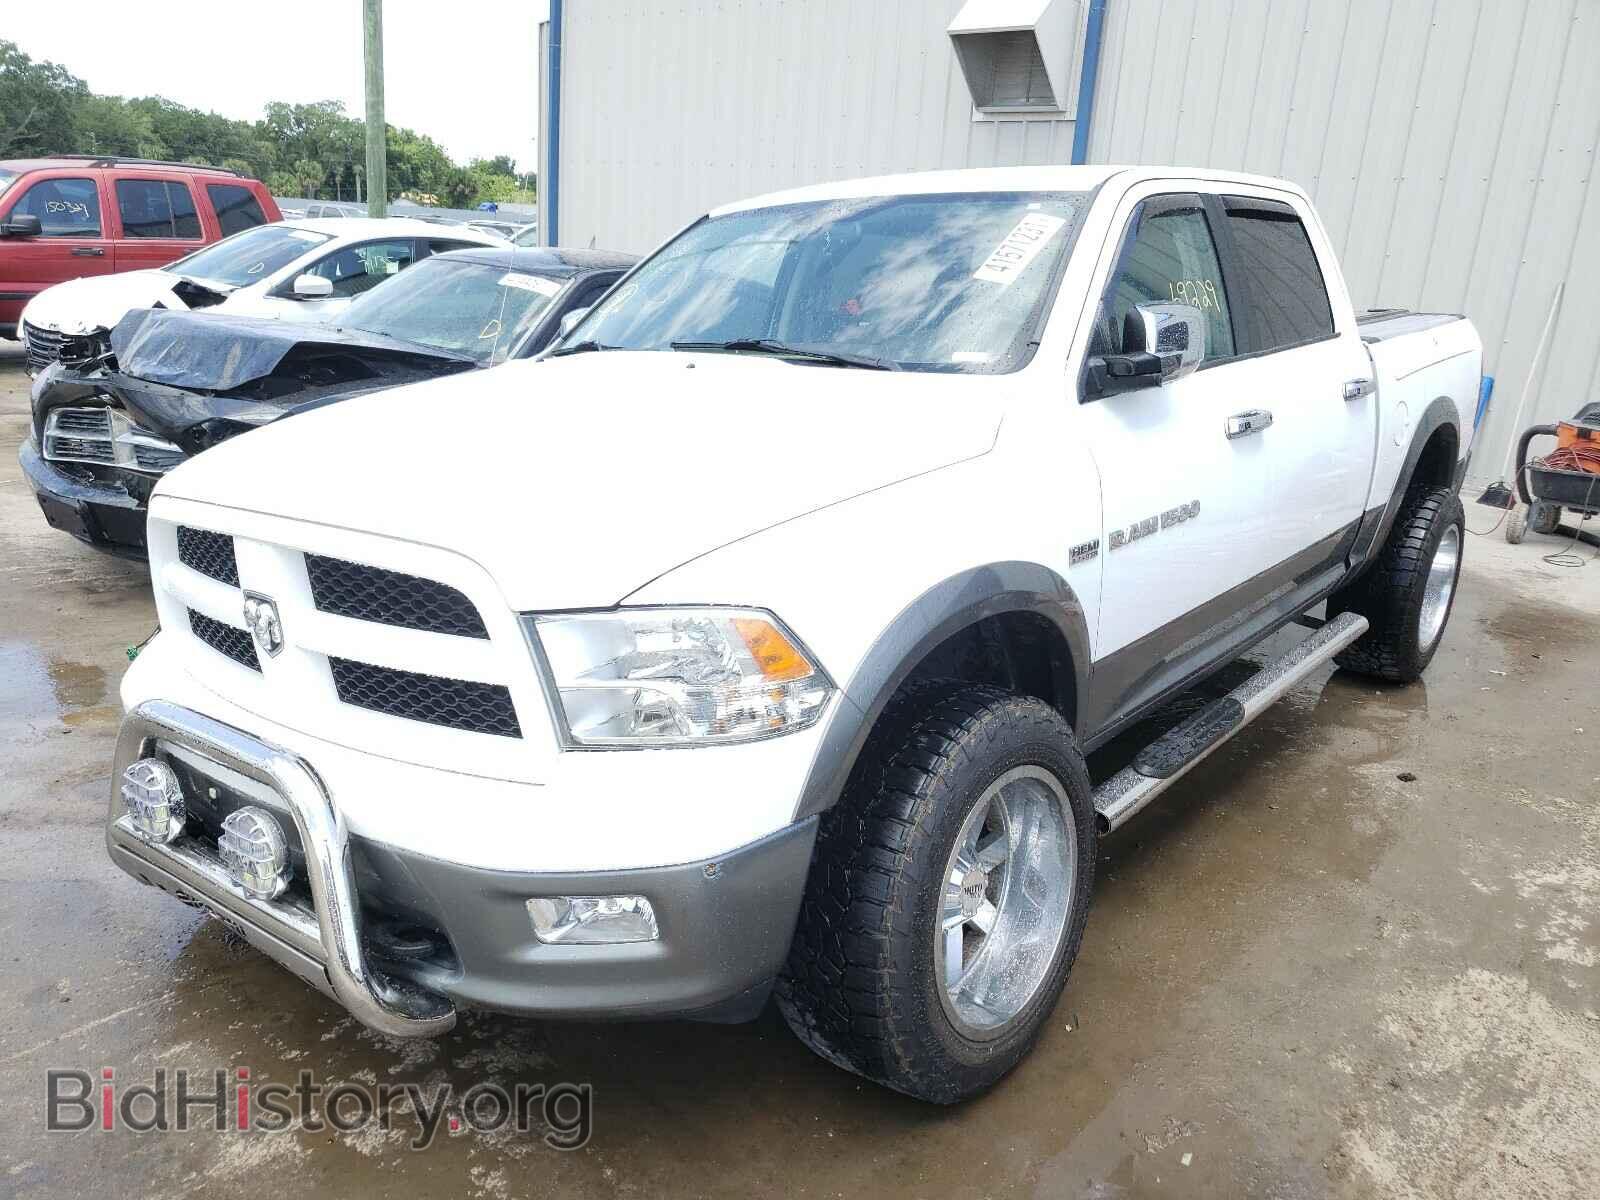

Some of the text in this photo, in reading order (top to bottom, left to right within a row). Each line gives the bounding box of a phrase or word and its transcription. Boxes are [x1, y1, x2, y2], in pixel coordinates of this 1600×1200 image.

[1108, 499, 1201, 552] RAM 1500
[1070, 538, 1100, 559] HEMI
